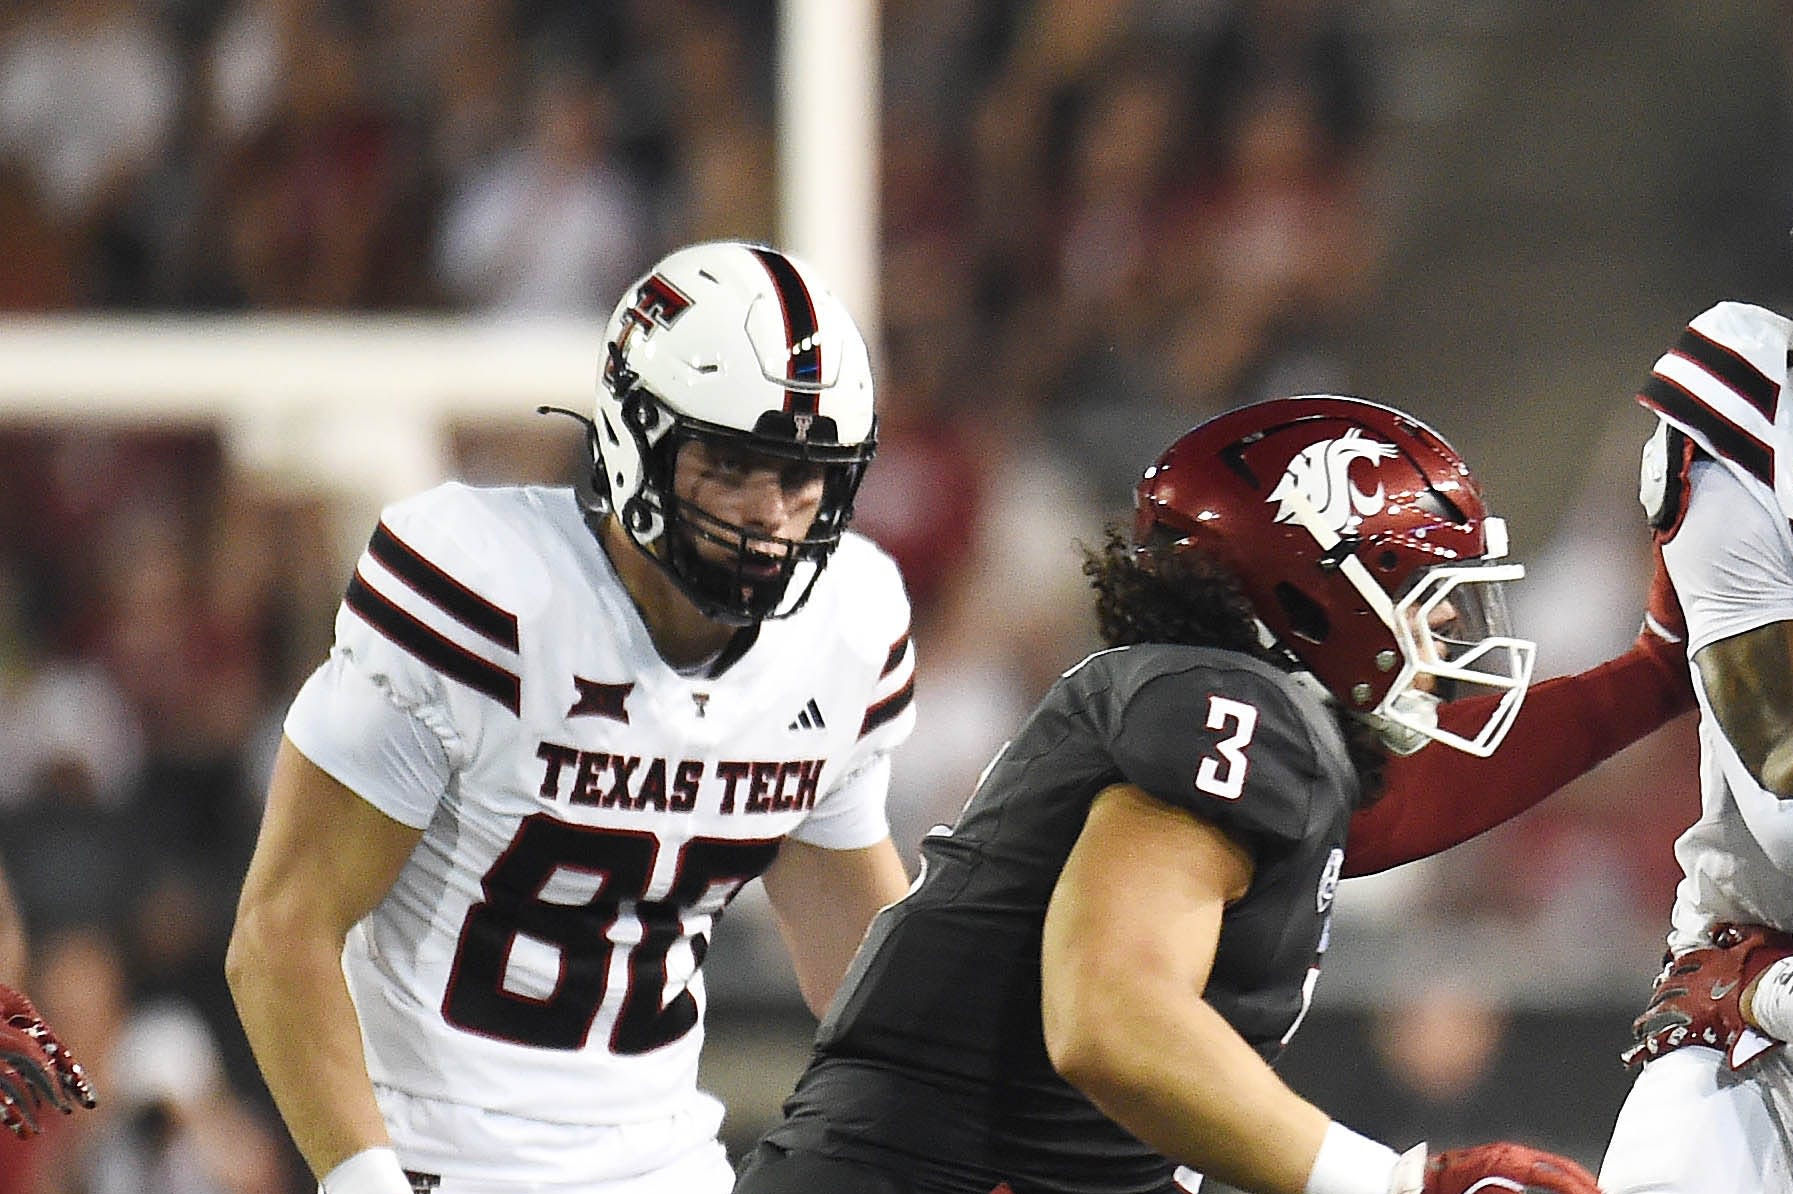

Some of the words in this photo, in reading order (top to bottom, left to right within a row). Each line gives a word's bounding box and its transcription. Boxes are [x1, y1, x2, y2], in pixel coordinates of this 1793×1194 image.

[536, 740, 705, 813] TEXAS
[715, 758, 827, 815] TECH
[1195, 694, 1259, 803] 3
